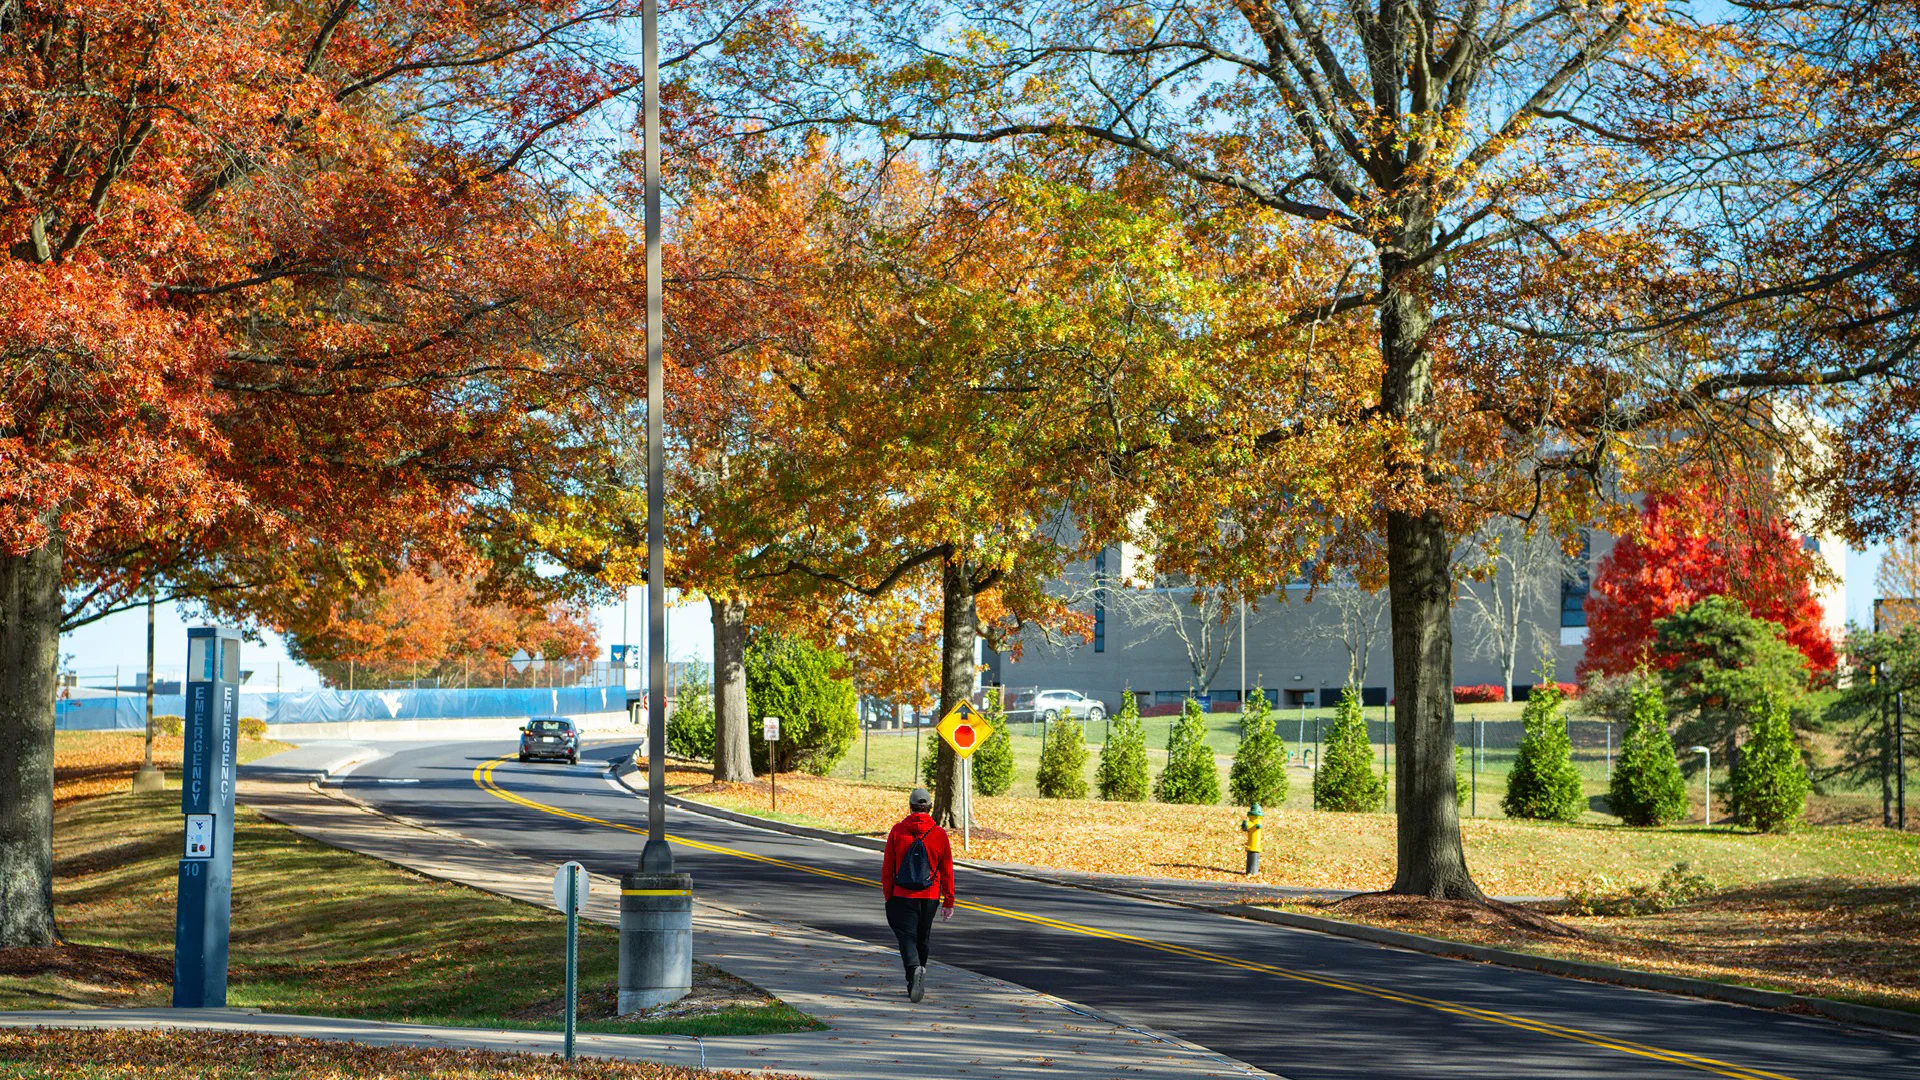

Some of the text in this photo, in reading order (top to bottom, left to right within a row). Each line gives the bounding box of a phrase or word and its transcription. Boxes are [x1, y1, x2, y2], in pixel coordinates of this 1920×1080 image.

[192, 687, 204, 806] EMERGENCY
[221, 687, 232, 806] EMERGENCY
[184, 862, 199, 876] 10
